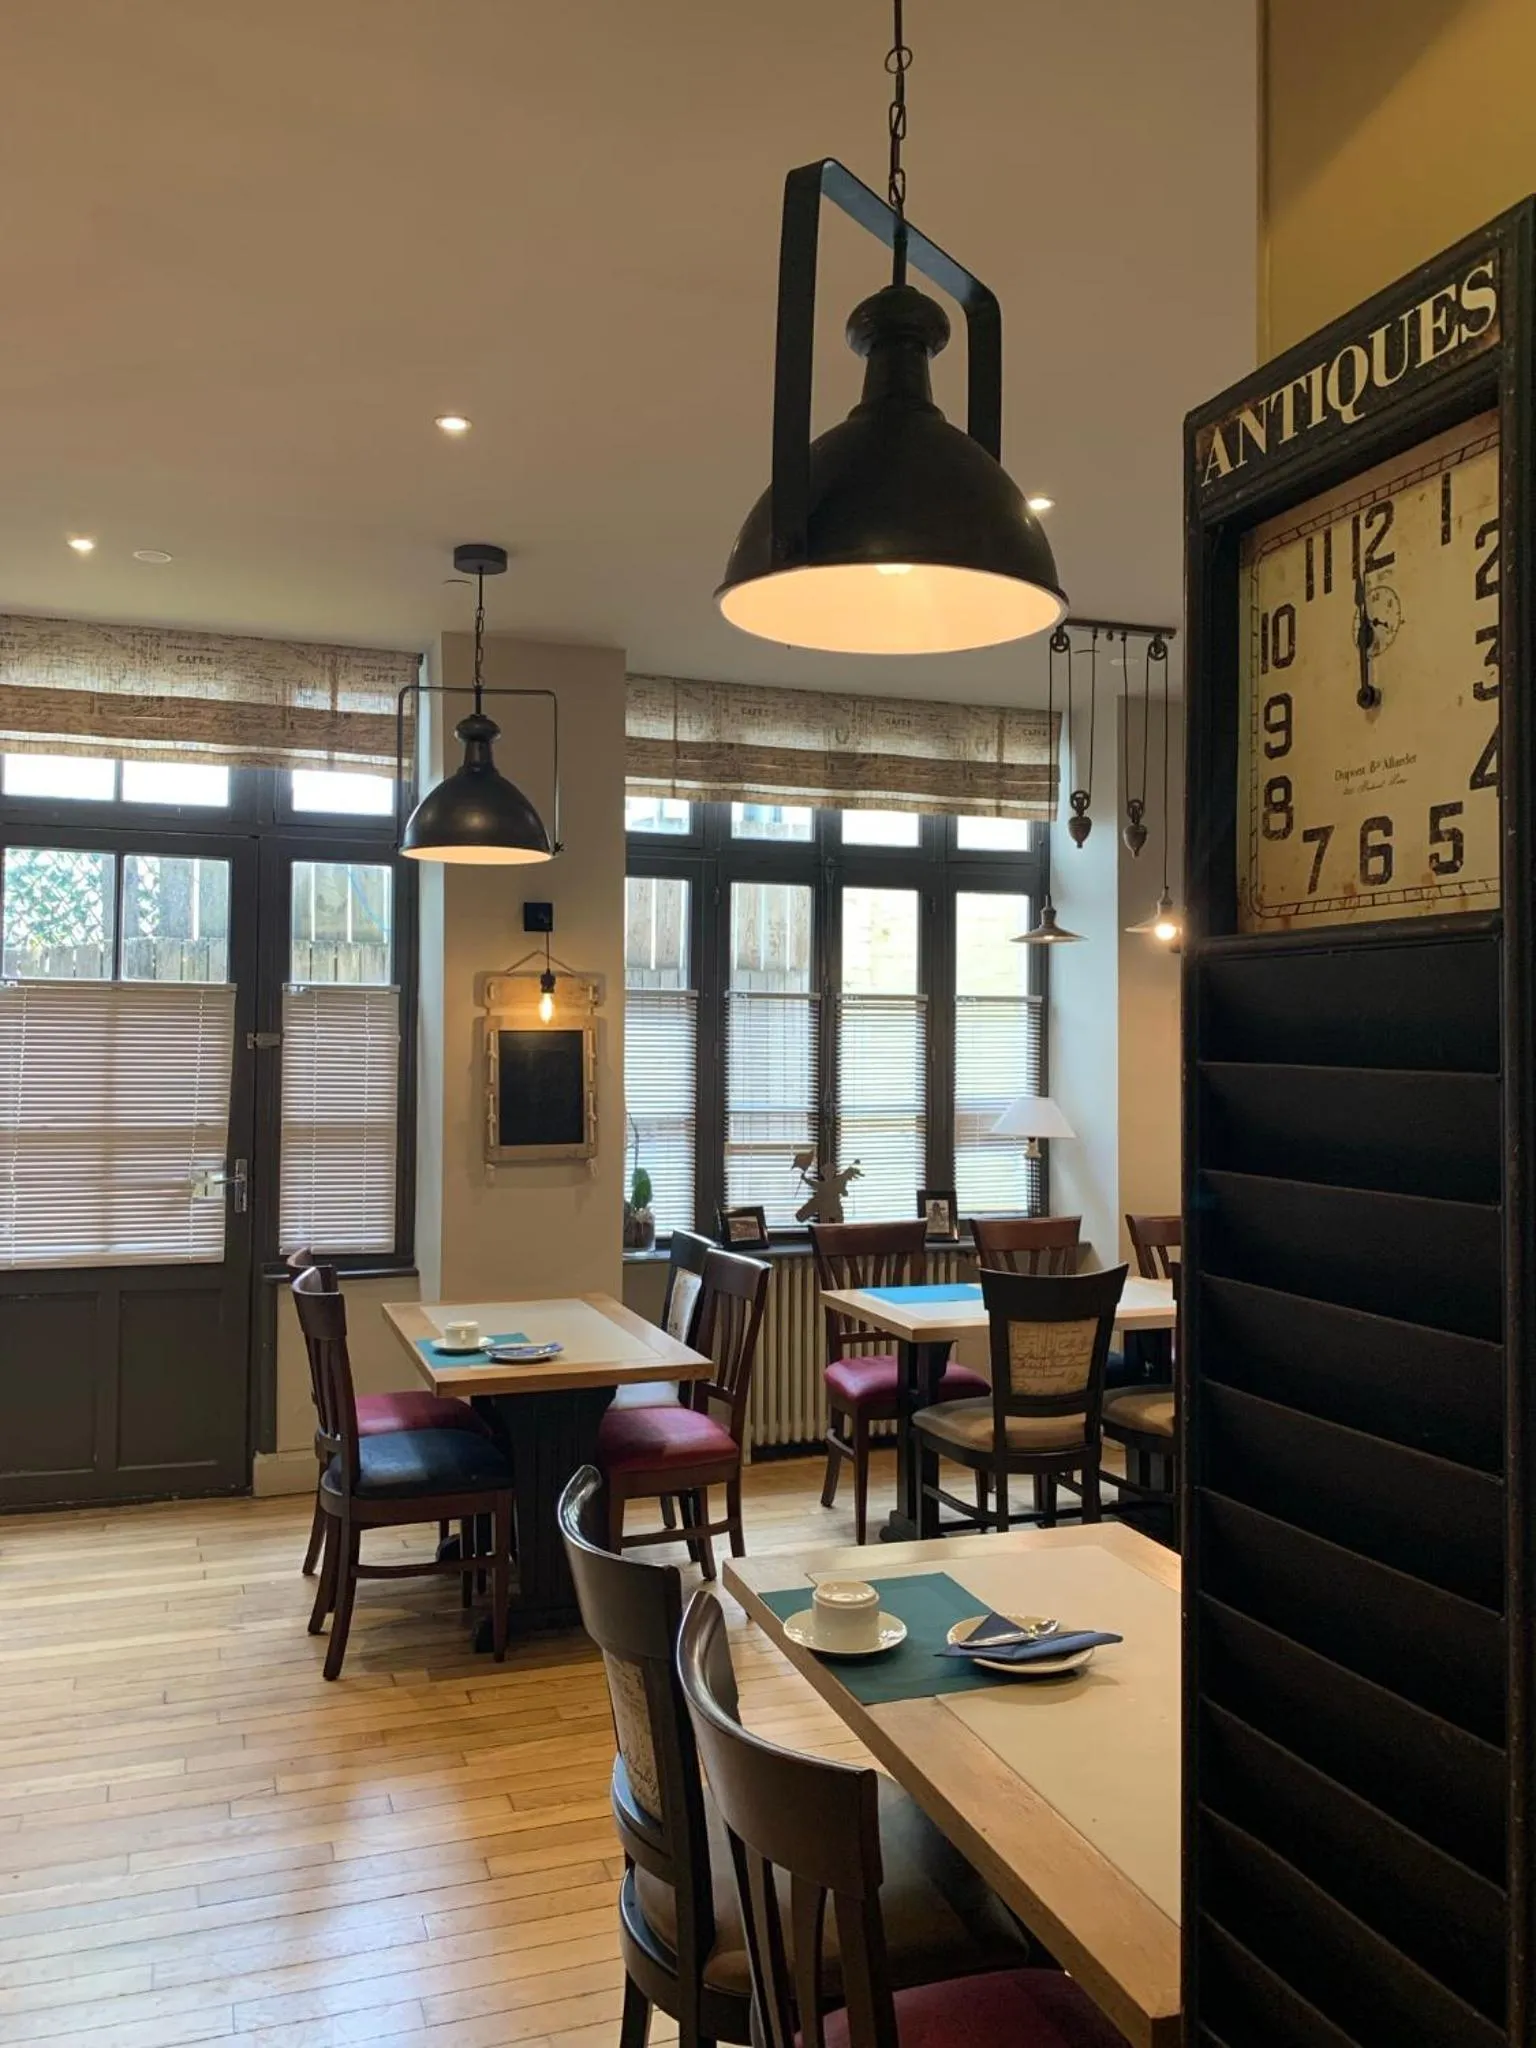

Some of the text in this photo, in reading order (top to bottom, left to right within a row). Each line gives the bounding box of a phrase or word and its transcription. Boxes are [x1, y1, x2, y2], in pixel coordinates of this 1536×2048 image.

[1201, 261, 1497, 488] ANTIQUES
[1305, 526, 1333, 602] 11
[1351, 499, 1396, 581] 12
[1475, 517, 1500, 601] 2
[1260, 603, 1296, 675] 10
[1263, 692, 1293, 760] 9
[1469, 721, 1500, 798] 4
[1261, 775, 1294, 841] 8
[1429, 801, 1464, 876] 5
[1302, 824, 1334, 895] 7
[1359, 815, 1393, 887] 6
